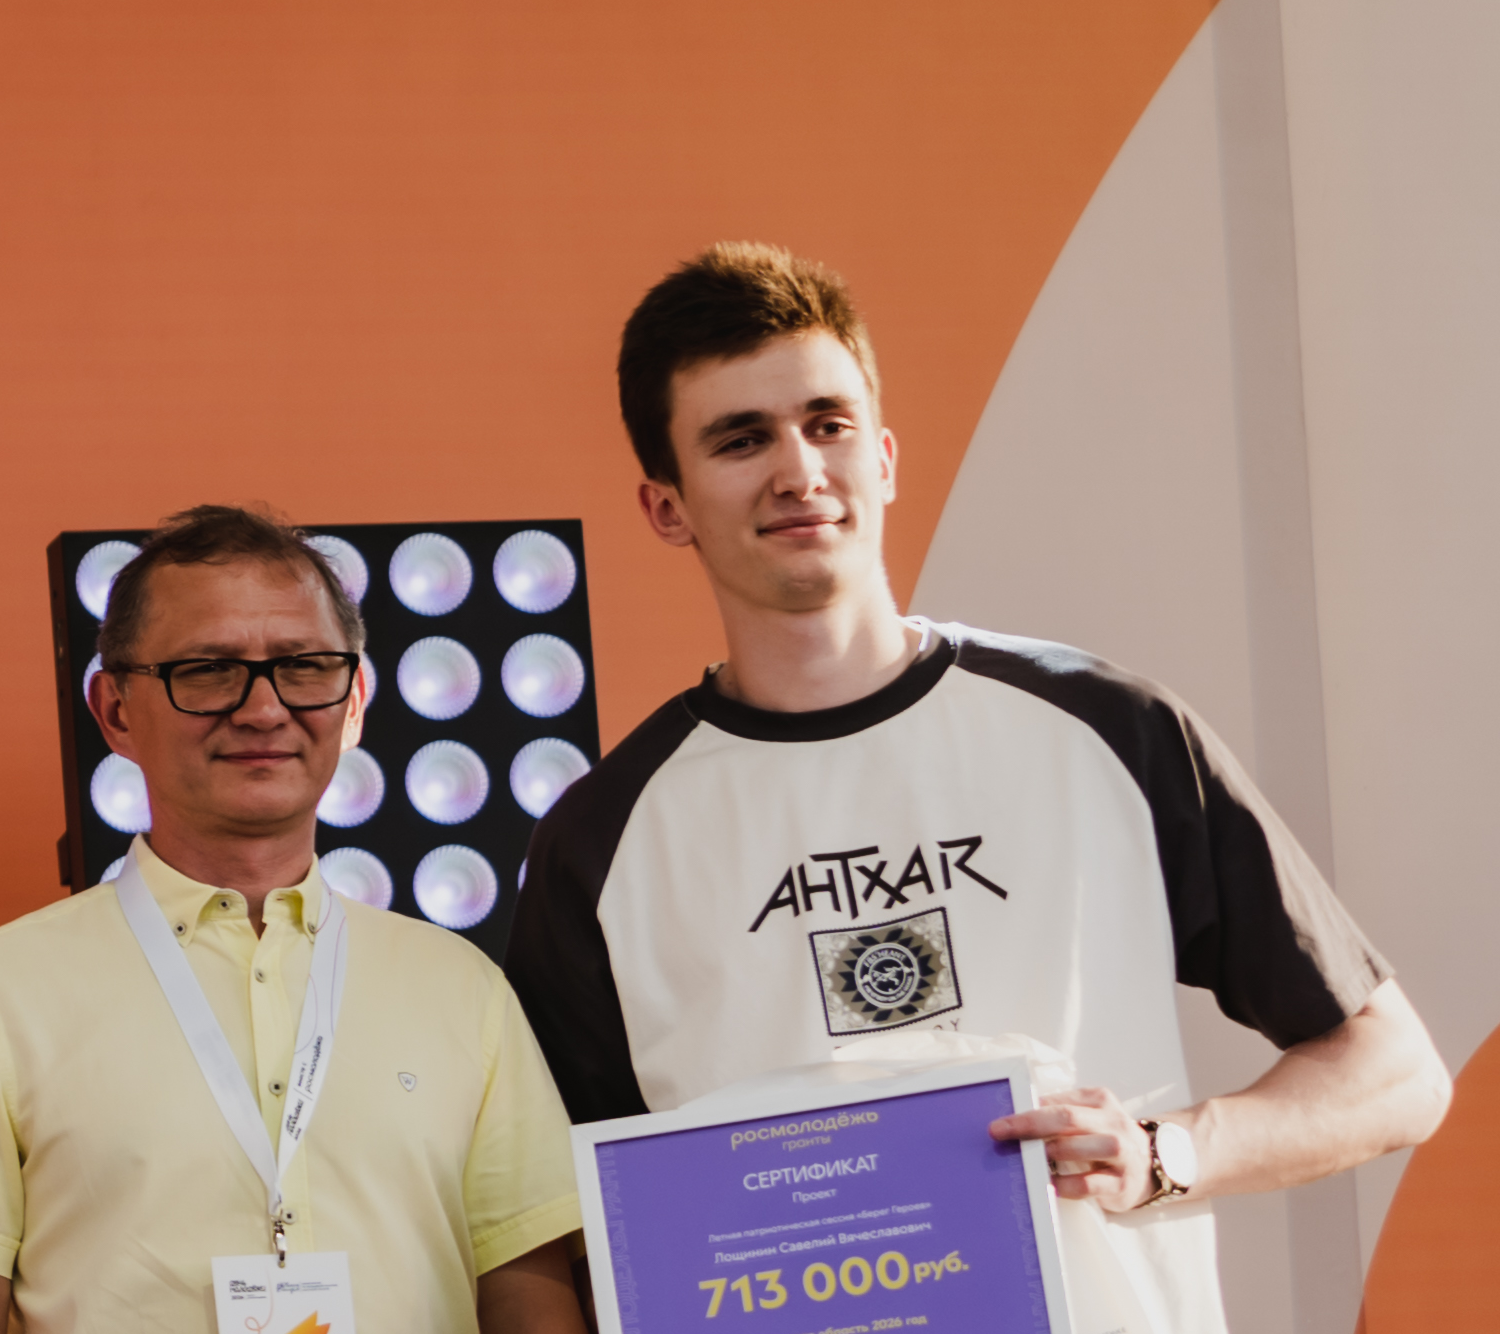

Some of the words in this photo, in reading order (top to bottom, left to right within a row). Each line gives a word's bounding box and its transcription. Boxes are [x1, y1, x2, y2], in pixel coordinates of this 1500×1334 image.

[742, 1153, 879, 1191] СЕРТИФИКАТ
[698, 1268, 788, 1319] 713
[802, 1250, 911, 1302] 000
[871, 1316, 904, 1332] 2026
